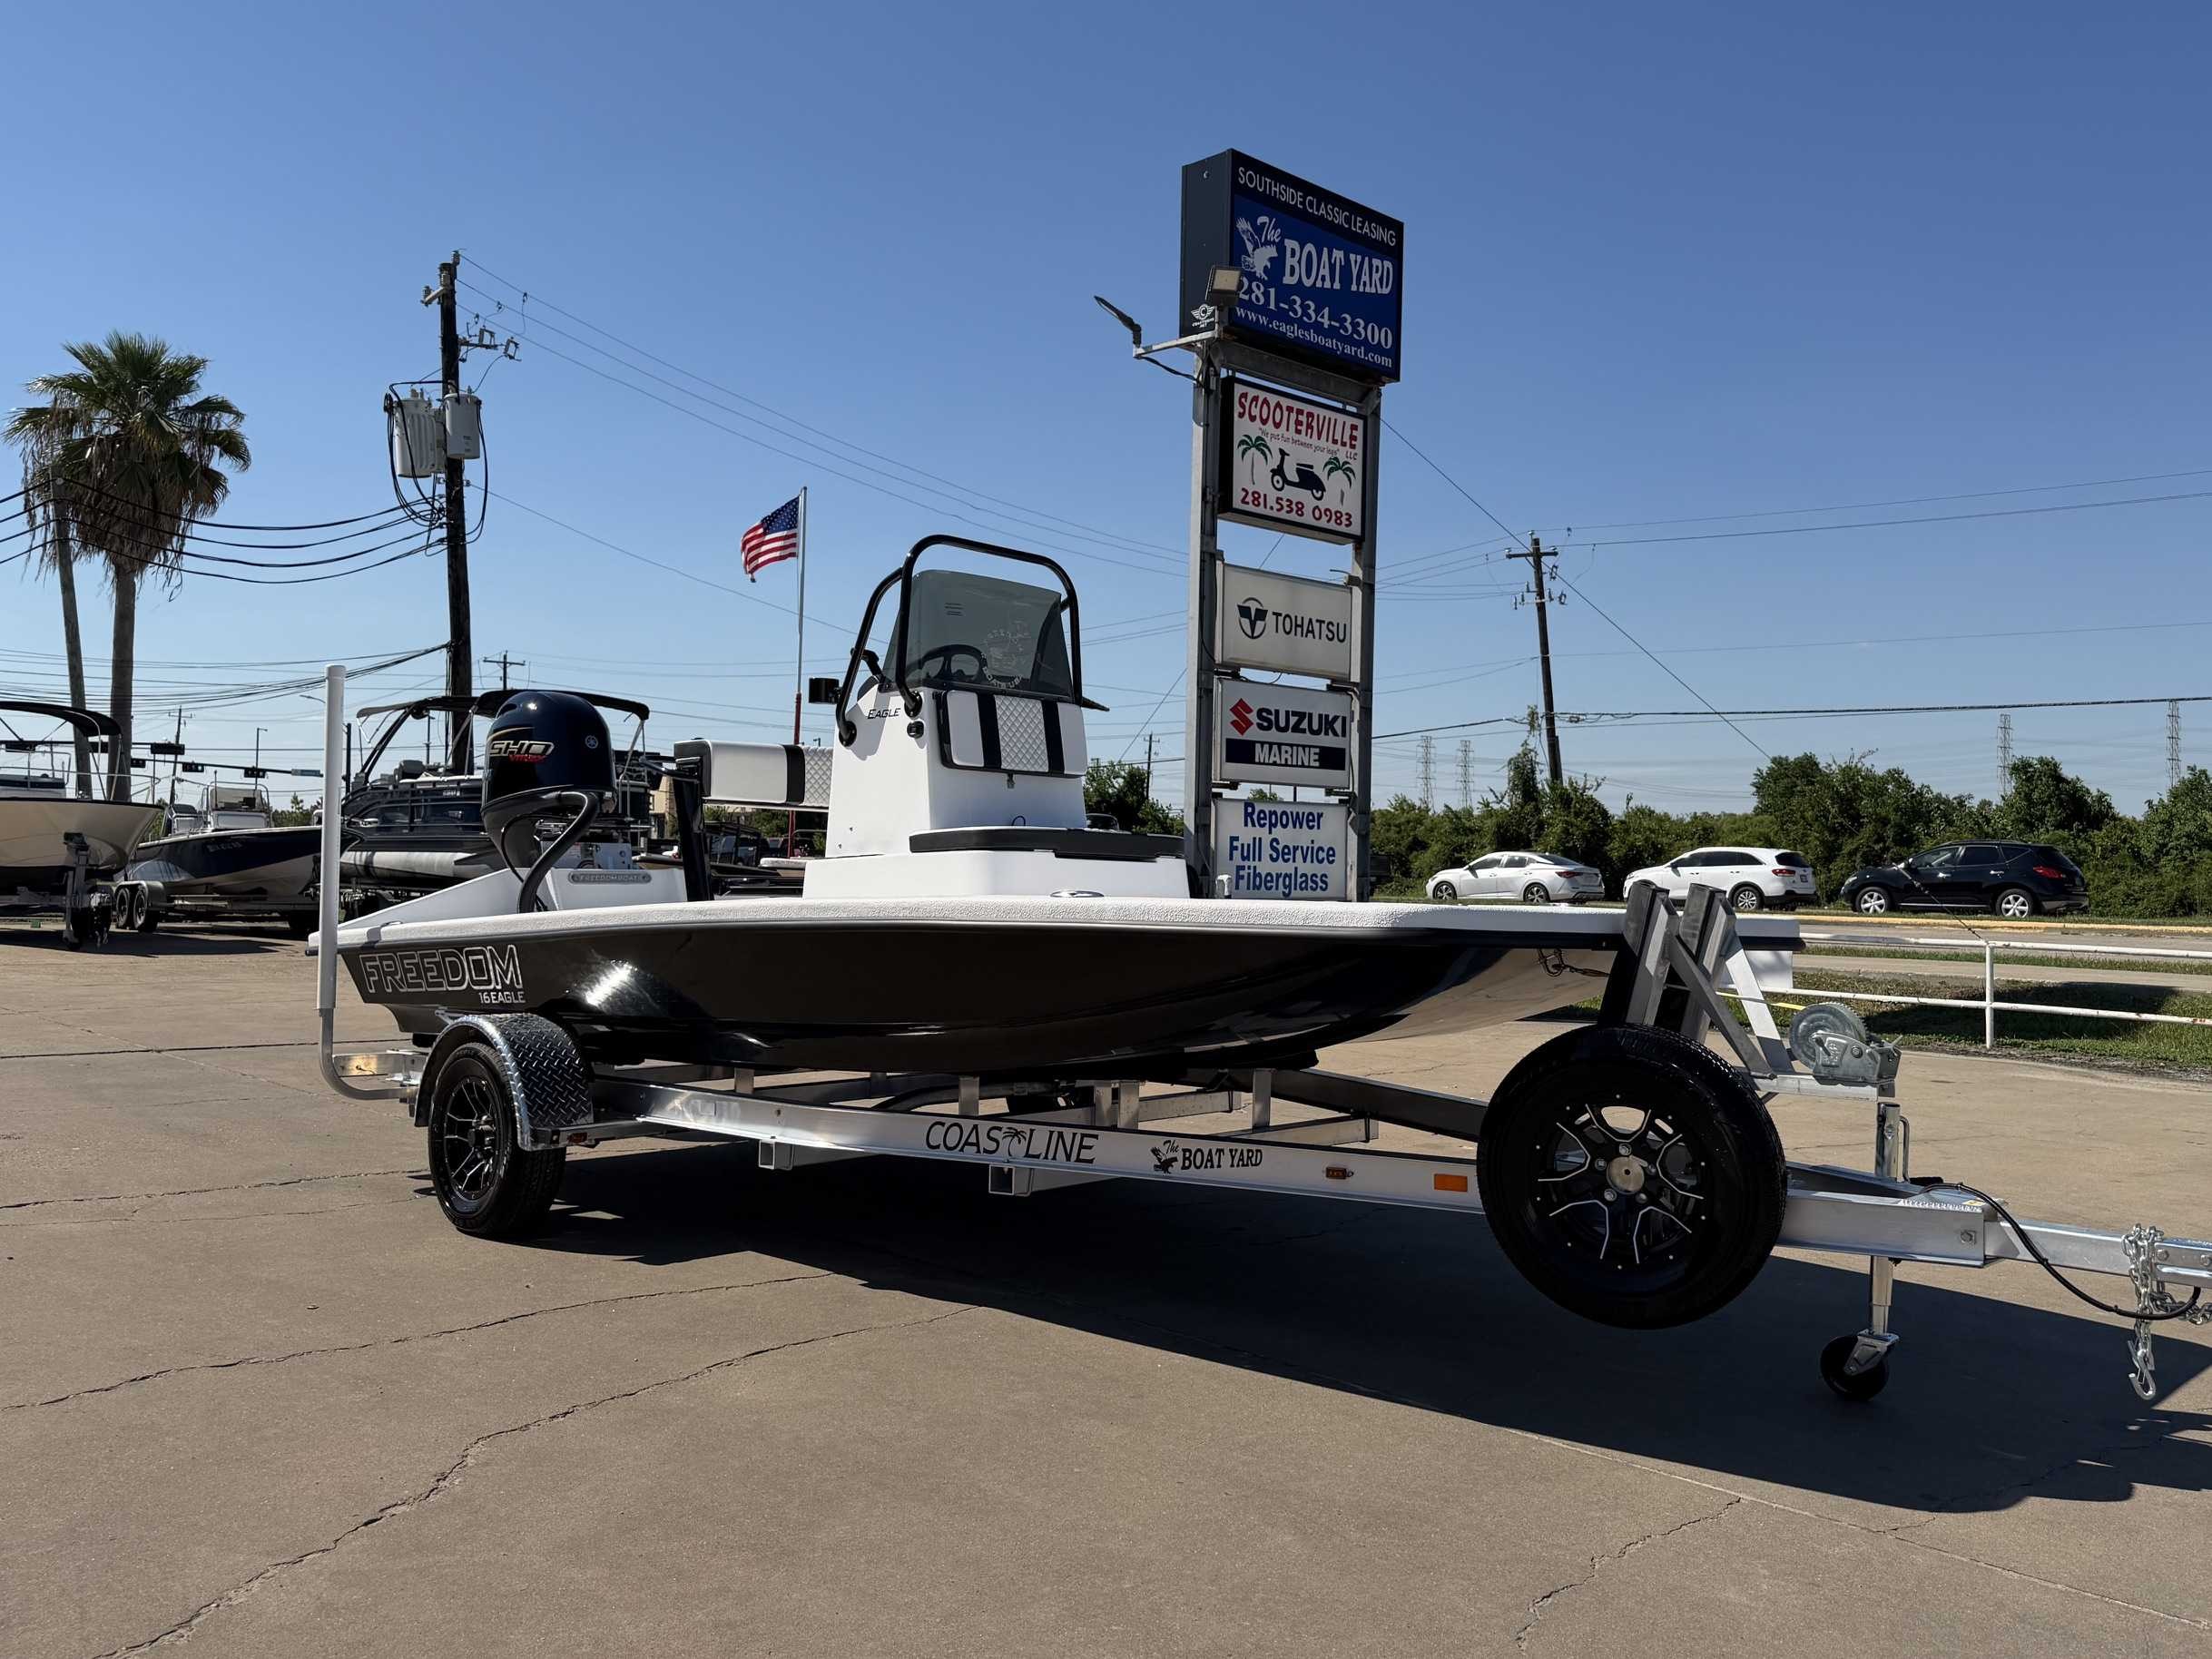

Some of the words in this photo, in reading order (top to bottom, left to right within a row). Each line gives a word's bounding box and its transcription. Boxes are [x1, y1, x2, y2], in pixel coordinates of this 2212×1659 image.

[1238, 166, 1303, 209] SOUTHSIDE
[1305, 196, 1350, 229] CLASSIC
[1351, 217, 1396, 247] LEASING
[1256, 216, 1282, 242] The
[1283, 238, 1344, 290] BOAT
[1349, 253, 1393, 295] YARD
[1239, 275, 1393, 349] 281-334-3300
[1235, 306, 1392, 368] www.eaglesboatyard.com
[1237, 391, 1359, 450] SCOOTERVILLE
[1345, 450, 1358, 461] LLC
[1312, 506, 1352, 528] 0983
[1272, 611, 1347, 643] TOHATSU
[867, 708, 900, 719] EAGLE
[1256, 707, 1347, 738] SUZUKI
[489, 741, 555, 756] SHO
[1254, 742, 1320, 767] MARINE
[1244, 801, 1323, 835] Repower
[1229, 836, 1263, 862] Full
[1269, 838, 1336, 865] Service
[1234, 865, 1329, 898] Fiberglass
[359, 944, 523, 994] FREEDOM
[1163, 1139, 1179, 1154] The
[1181, 1148, 1224, 1170] BOAT
[1229, 1148, 1263, 1168] YARD
